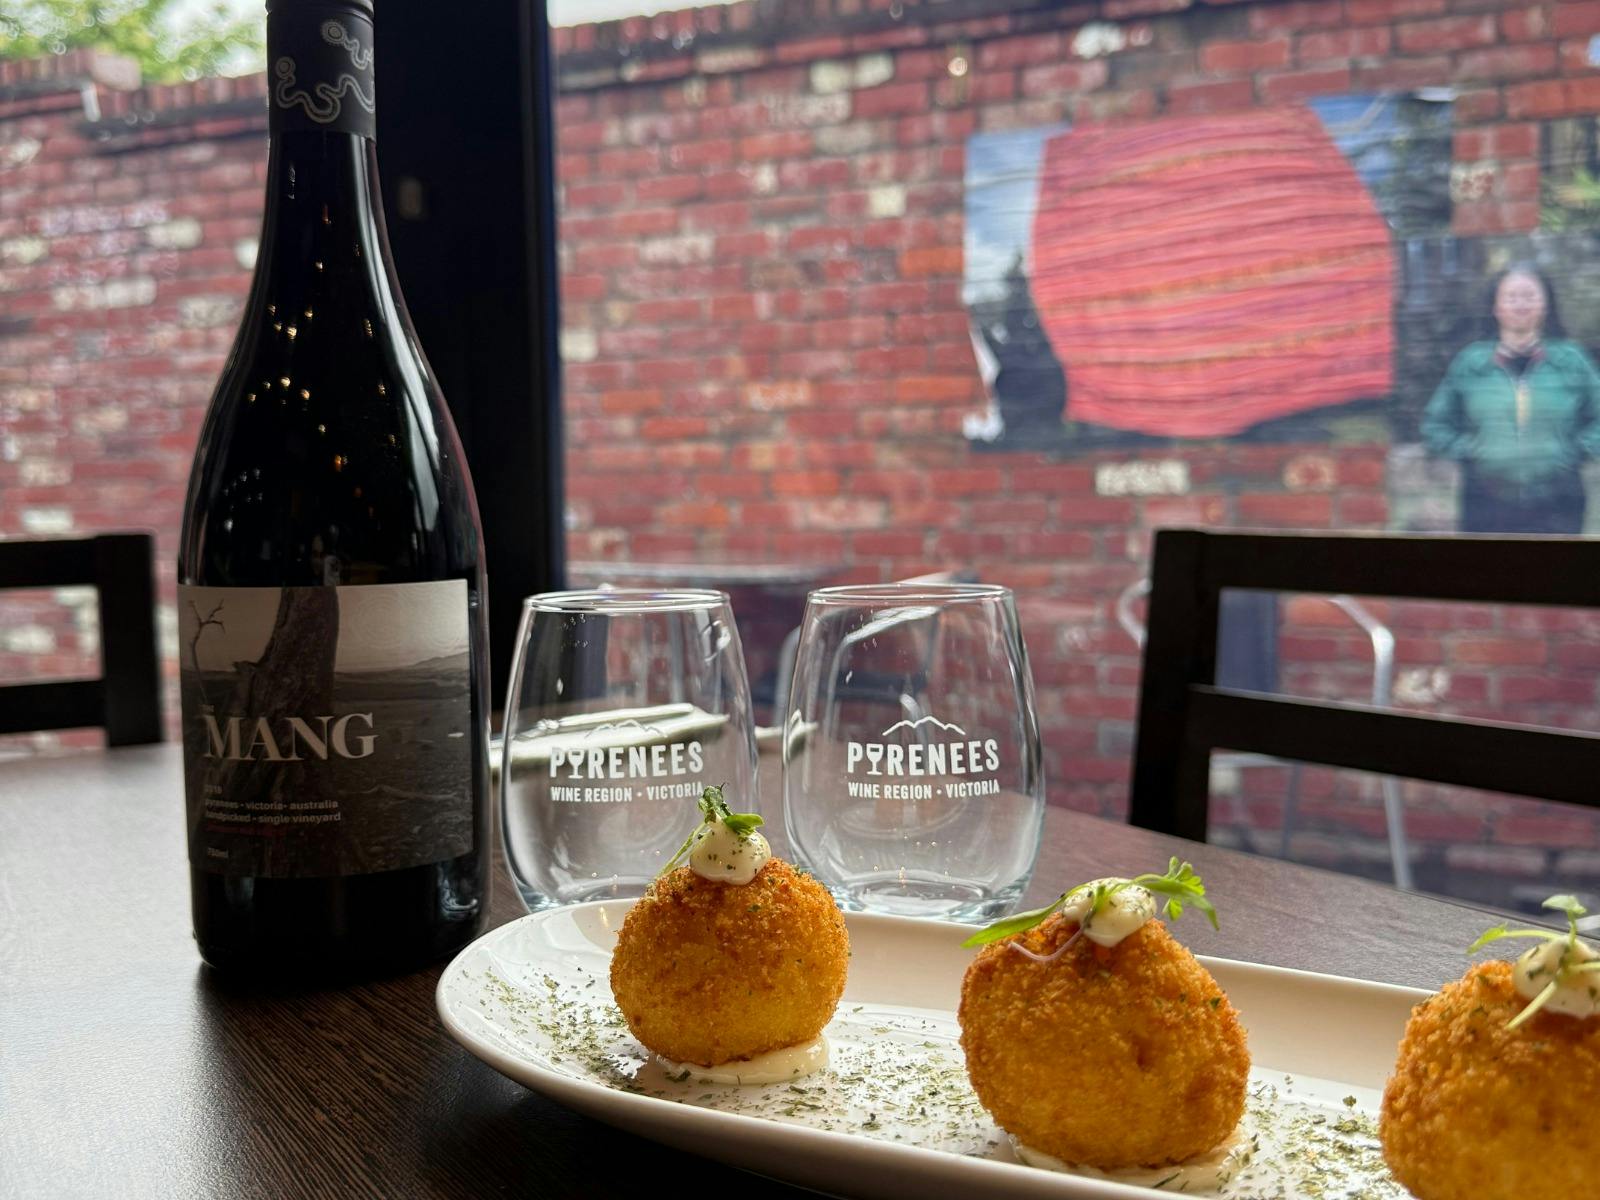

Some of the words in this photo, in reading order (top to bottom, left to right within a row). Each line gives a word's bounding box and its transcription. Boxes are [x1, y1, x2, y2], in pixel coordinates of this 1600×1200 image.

[203, 712, 378, 761] MANG
[549, 741, 704, 779] PYRENEES
[848, 739, 1000, 776] PYRENEES
[551, 786, 582, 802] WINE
[584, 787, 633, 803] REGION
[646, 781, 704, 801] VICTORIA
[848, 781, 880, 799] WINE
[883, 784, 932, 800] REGION
[945, 779, 1000, 798] VICTORIA
[204, 799, 239, 810] pyes
[245, 801, 284, 811] victoria
[290, 800, 339, 810] australia
[204, 811, 251, 824] picked
[259, 814, 290, 826] single
[292, 811, 342, 825] vineyard
